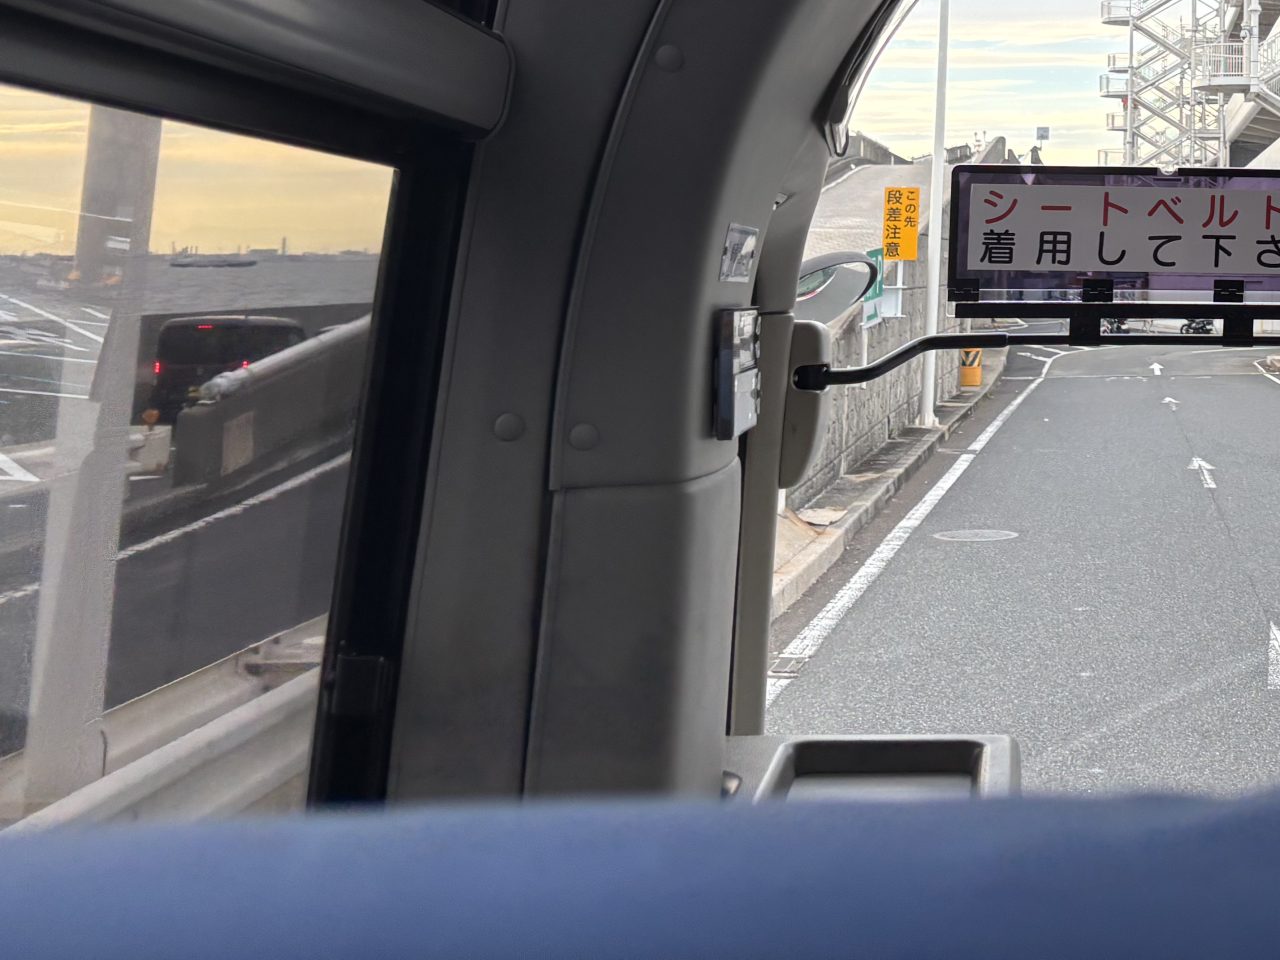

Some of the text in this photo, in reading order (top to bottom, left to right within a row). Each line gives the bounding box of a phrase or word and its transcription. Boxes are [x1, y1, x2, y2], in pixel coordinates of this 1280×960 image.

[885, 189, 903, 257] 段差注意
[904, 191, 916, 228] この先
